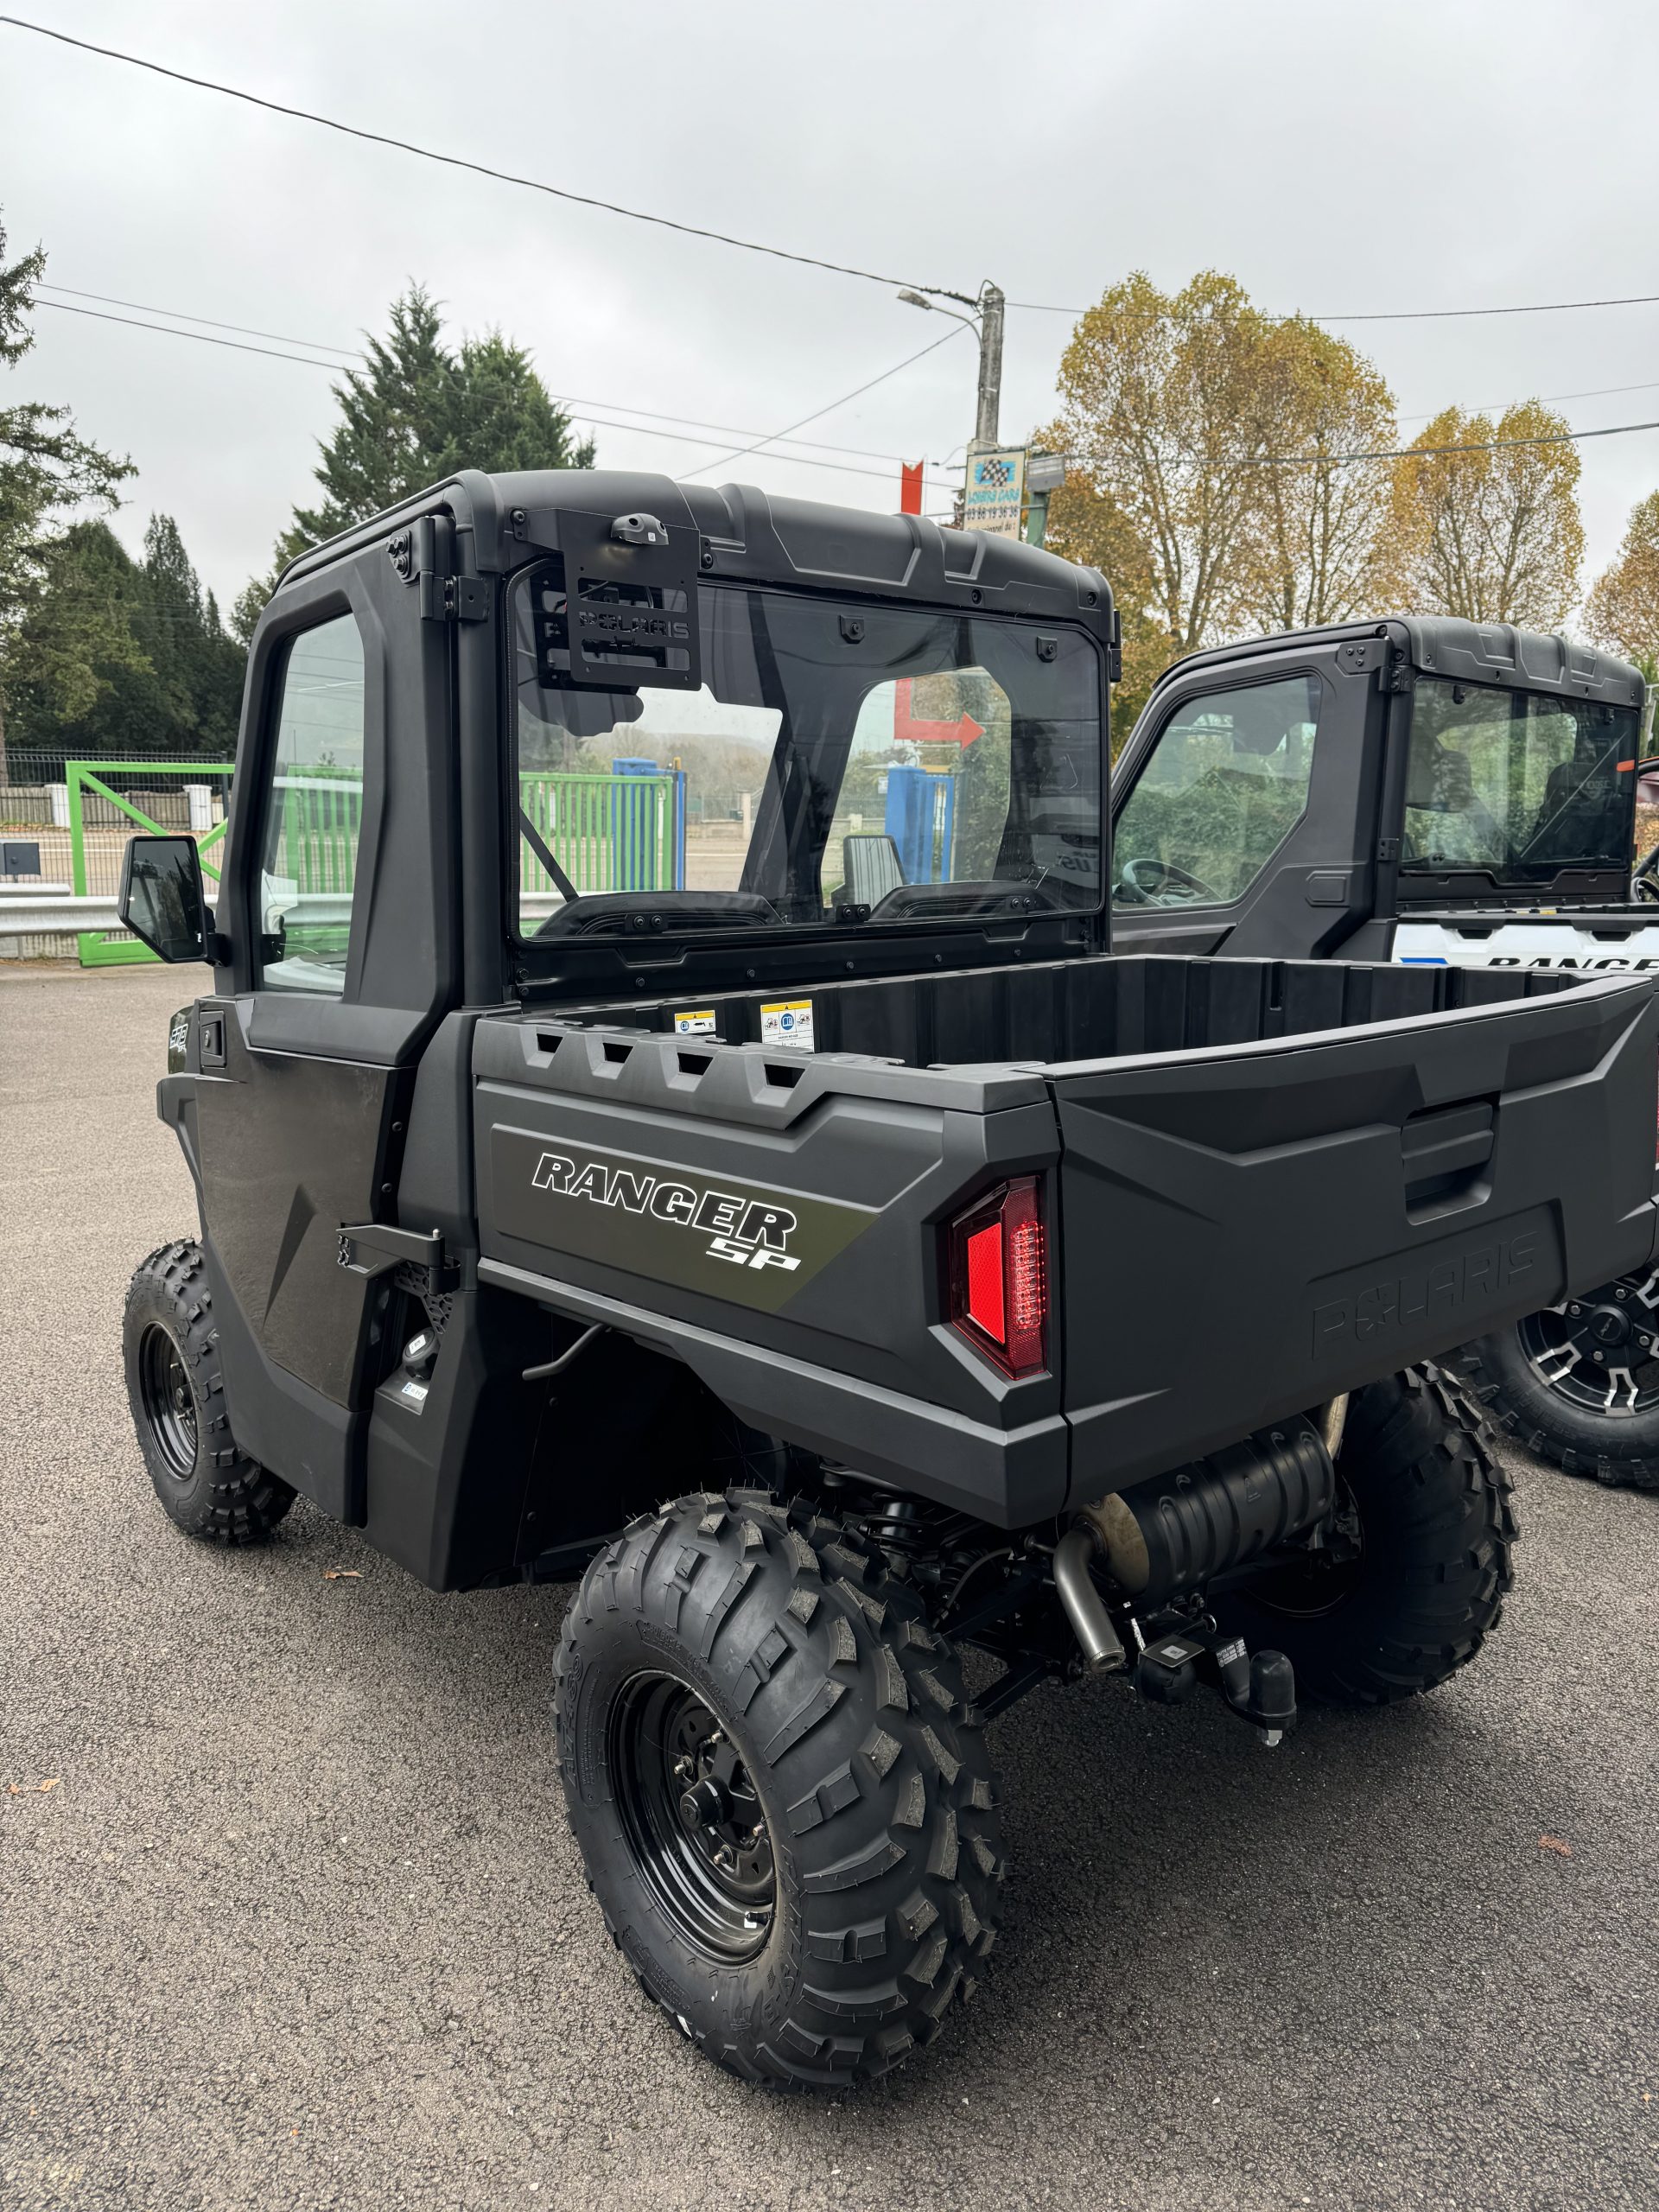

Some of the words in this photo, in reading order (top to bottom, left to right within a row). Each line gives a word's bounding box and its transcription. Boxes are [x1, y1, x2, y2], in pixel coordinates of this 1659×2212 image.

[578, 611, 690, 639] POLARIS
[531, 1153, 798, 1251] RANGER
[705, 1236, 802, 1272] SP
[1311, 1230, 1541, 1362] POLARIS
